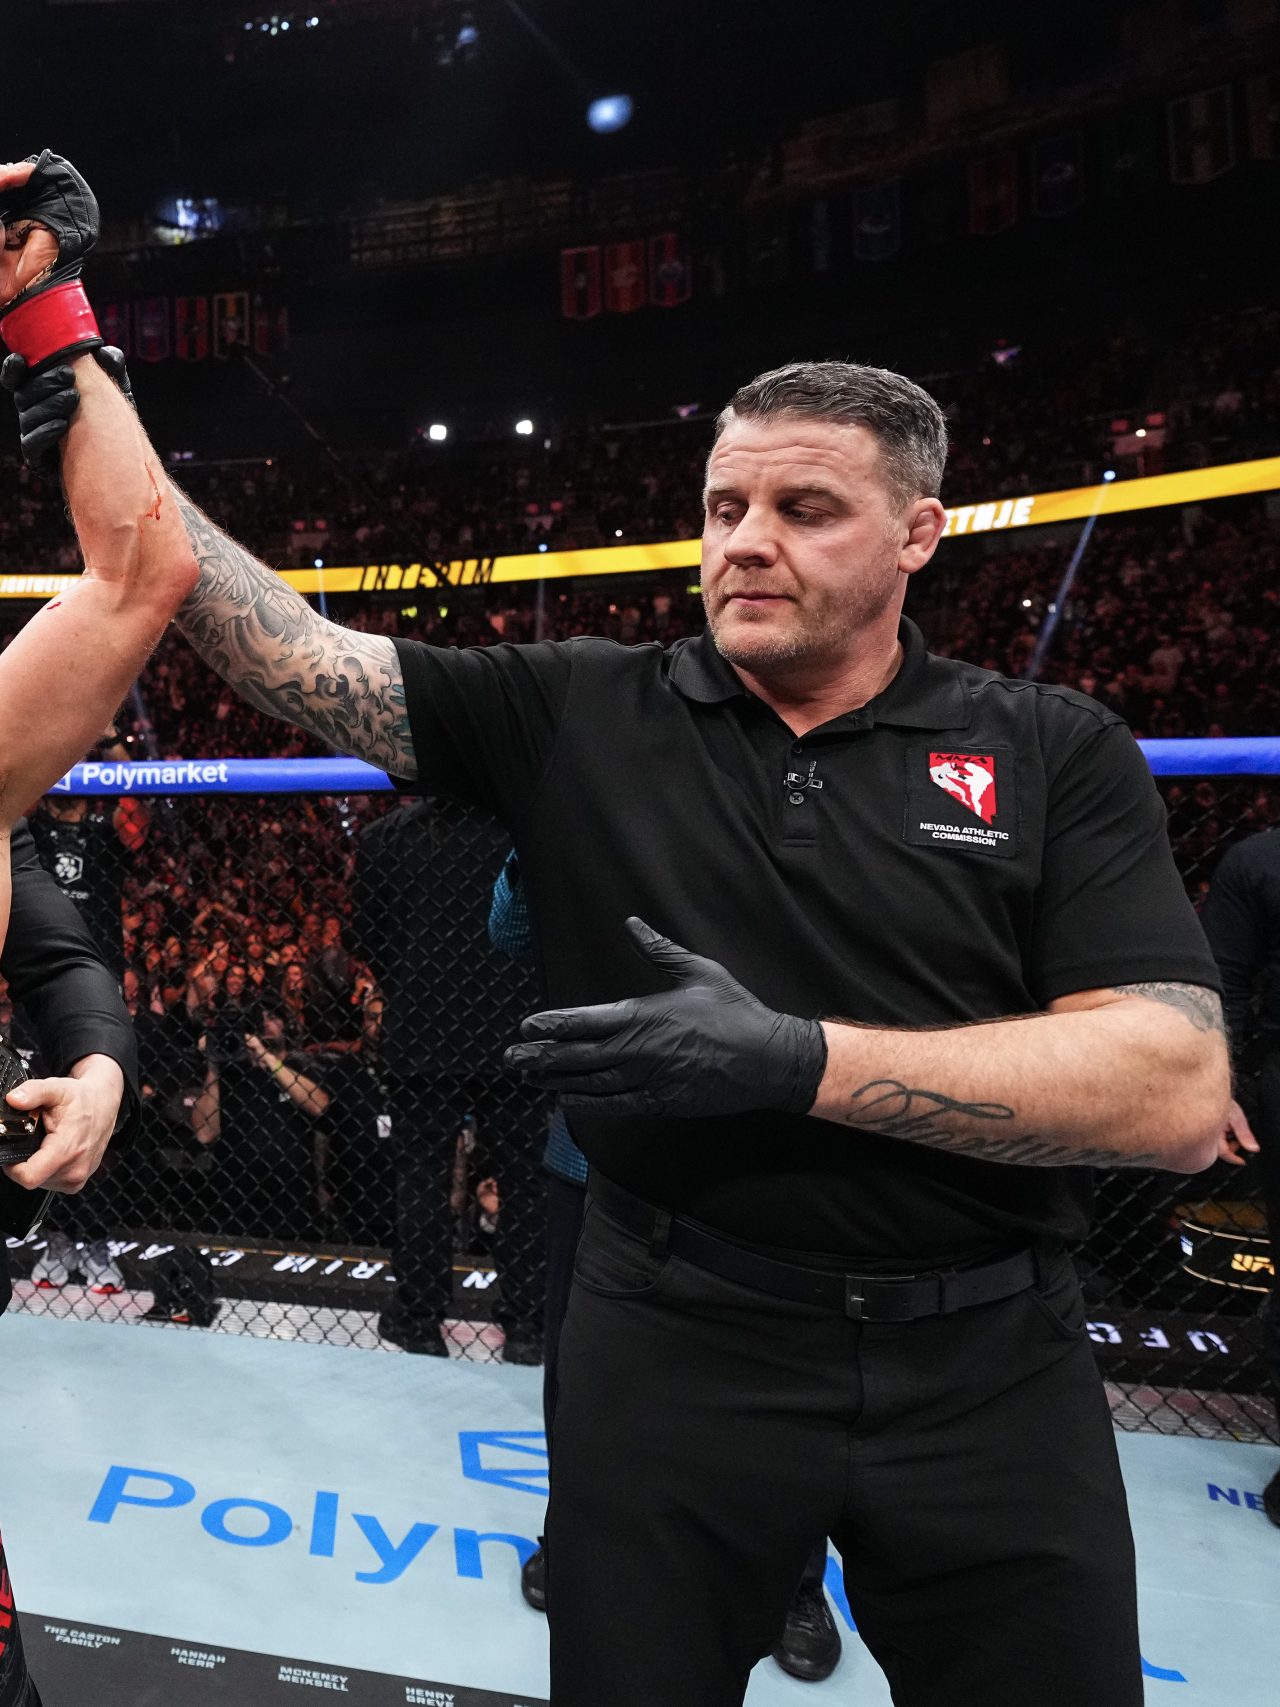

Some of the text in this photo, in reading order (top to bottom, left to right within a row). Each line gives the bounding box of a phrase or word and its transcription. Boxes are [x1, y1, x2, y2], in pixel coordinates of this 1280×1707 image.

[82, 762, 228, 790] Polymarket
[919, 822, 1010, 840] NEVADA ATHLETIC
[931, 831, 997, 847] COMMISSION
[43, 1624, 121, 1646] THE CASTON
[55, 1635, 103, 1649] FAMILY
[170, 1647, 226, 1664] HANNAH
[177, 1657, 215, 1670] KERR
[279, 1665, 349, 1684] MCKENZY
[405, 1686, 455, 1702] HENRY
